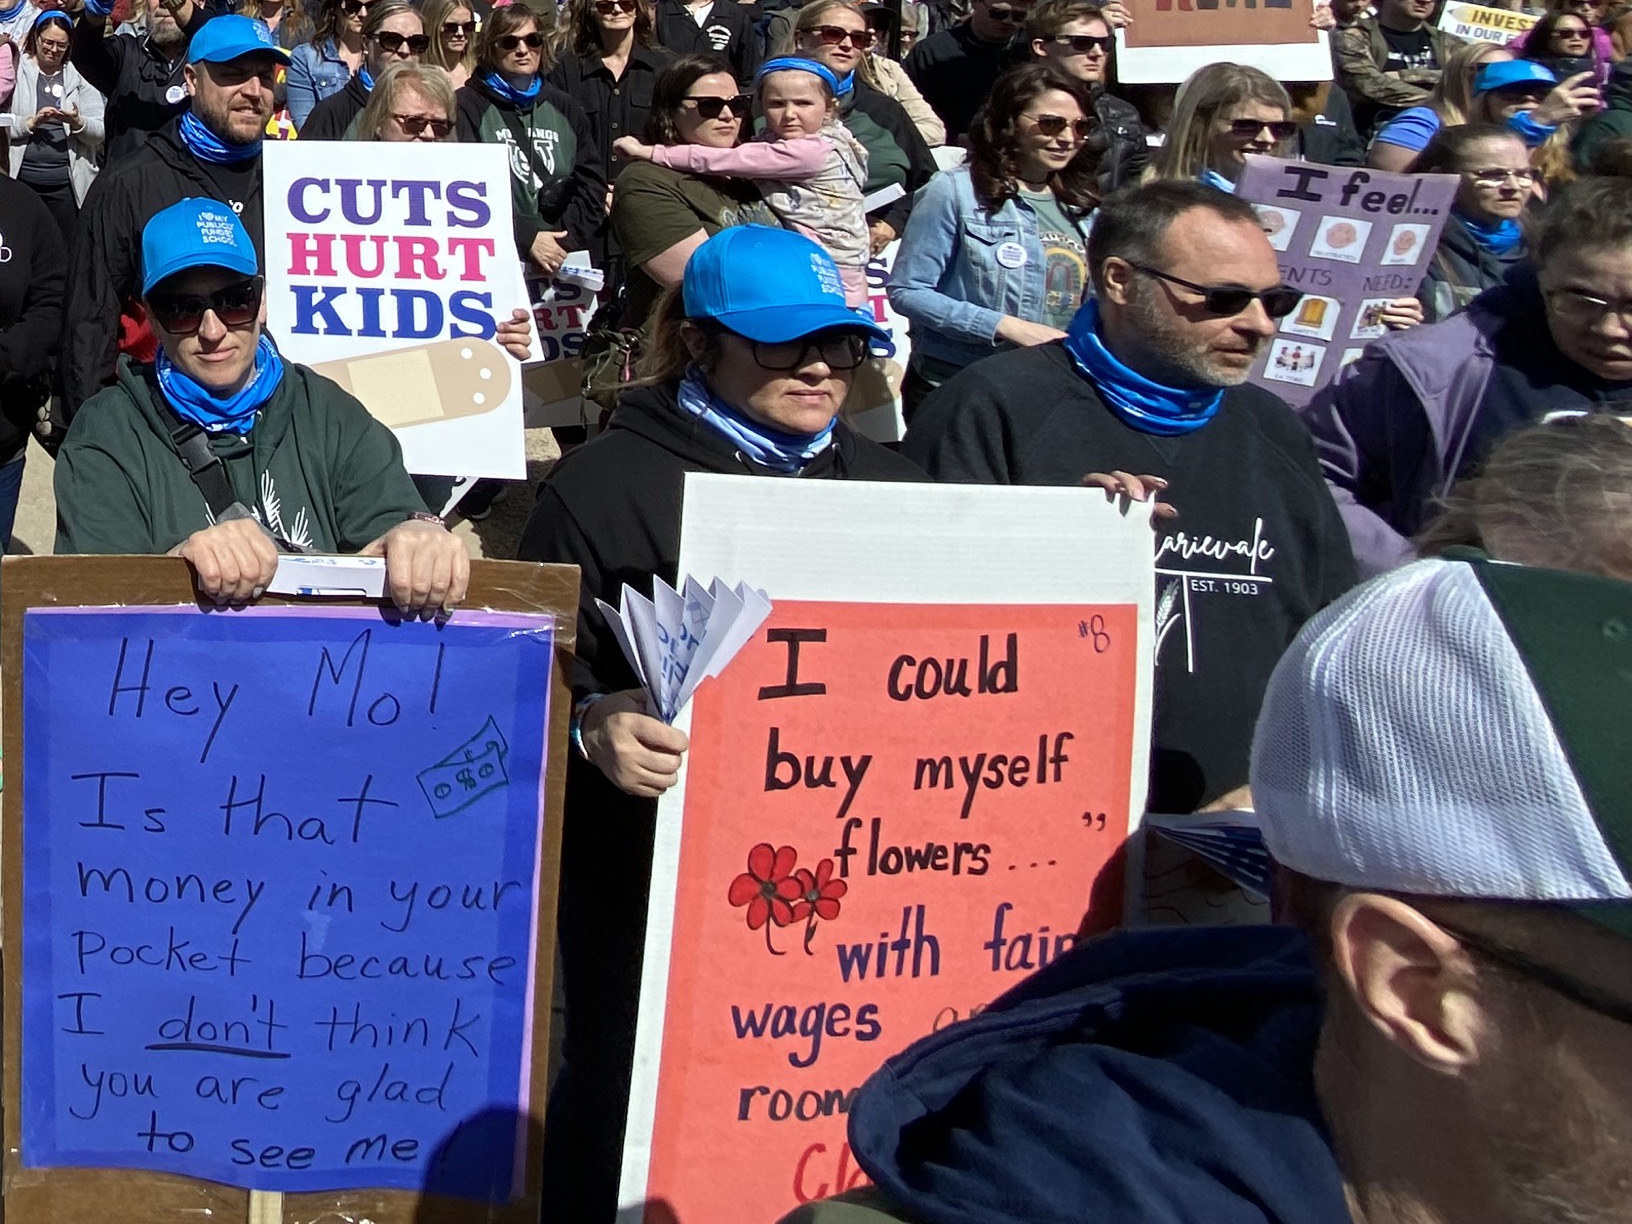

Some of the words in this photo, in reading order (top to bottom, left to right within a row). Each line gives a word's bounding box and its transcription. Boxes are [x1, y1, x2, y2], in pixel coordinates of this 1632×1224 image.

[1455, 24, 1470, 35] IN
[1473, 27, 1503, 42] OUR
[286, 177, 493, 228] CUTS
[1277, 166, 1328, 202] I
[286, 232, 496, 281] HURT
[290, 284, 497, 341] KIDS
[1155, 517, 1275, 575] arievale
[1191, 579, 1219, 593] EST.
[1224, 582, 1258, 595] 1903
[757, 628, 827, 700] I
[887, 633, 1019, 702] could
[108, 637, 238, 764] Hey
[309, 628, 447, 729] Mo!
[764, 727, 873, 818] buy
[913, 733, 1075, 819] myself
[71, 772, 167, 833] Is
[219, 774, 400, 844] that
[76, 861, 265, 934] money
[307, 870, 354, 912] in
[388, 877, 522, 927] your
[297, 930, 517, 983] because
[836, 906, 941, 982] with
[58, 991, 103, 1035] I
[158, 994, 289, 1052] don't
[315, 997, 479, 1057] think
[731, 1001, 882, 1068] wages
[70, 1062, 155, 1119] you
[196, 1075, 284, 1111] are
[325, 1061, 448, 1121] glad
[138, 1109, 194, 1154] to
[231, 1138, 314, 1169] see
